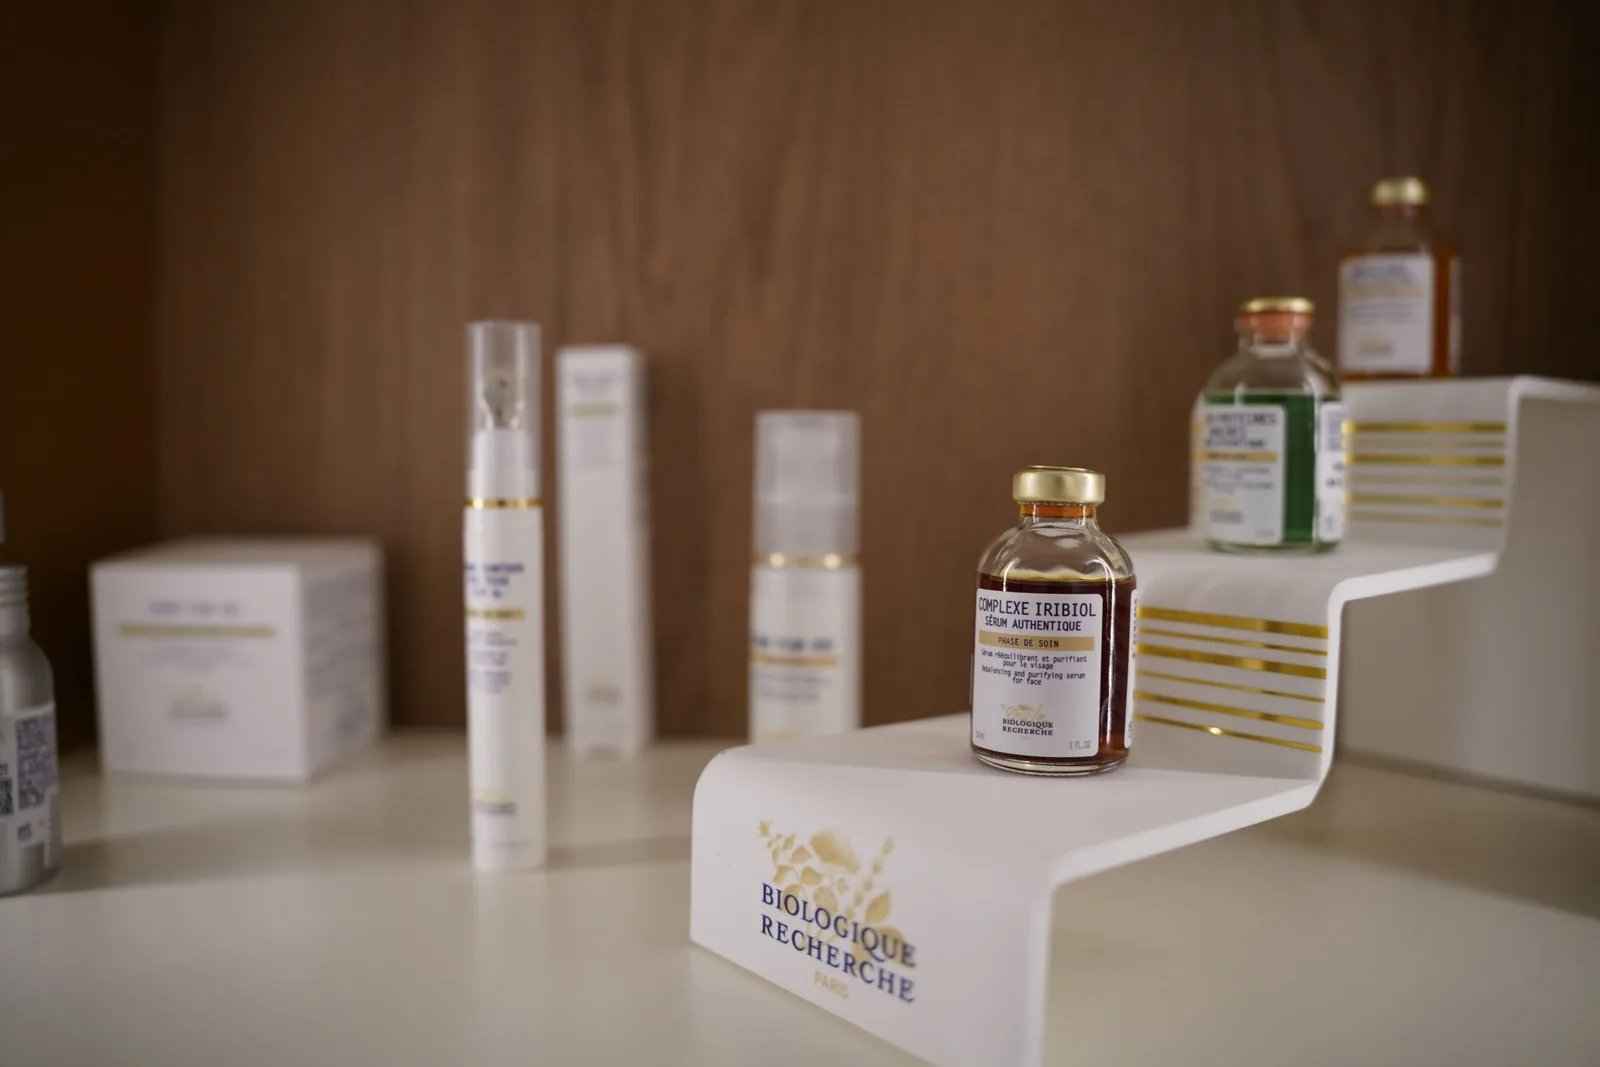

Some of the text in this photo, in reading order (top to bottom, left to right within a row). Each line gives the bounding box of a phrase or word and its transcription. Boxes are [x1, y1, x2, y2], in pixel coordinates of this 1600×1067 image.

[979, 597, 1096, 617] COMPLEXE IRIBIOL
[985, 615, 1081, 631] SÉRUM AUTHENTIQUE
[998, 636, 1019, 645] PHASE
[1039, 640, 1059, 648] SOIN
[994, 651, 1038, 662] rééquilibrant
[1053, 655, 1087, 663] purifiant
[1020, 660, 1027, 668] le
[1031, 662, 1053, 670] visage
[1014, 669, 1025, 677] and
[1029, 671, 1063, 680] purifying
[1027, 677, 1041, 685] face
[1002, 718, 1053, 728] BIOLOGIQUE
[1002, 726, 1053, 735] RECHERCHE
[761, 882, 917, 968] BIOLOGIQUE
[760, 913, 916, 1003] RECHERCHE
[814, 971, 850, 1000] PARIS
